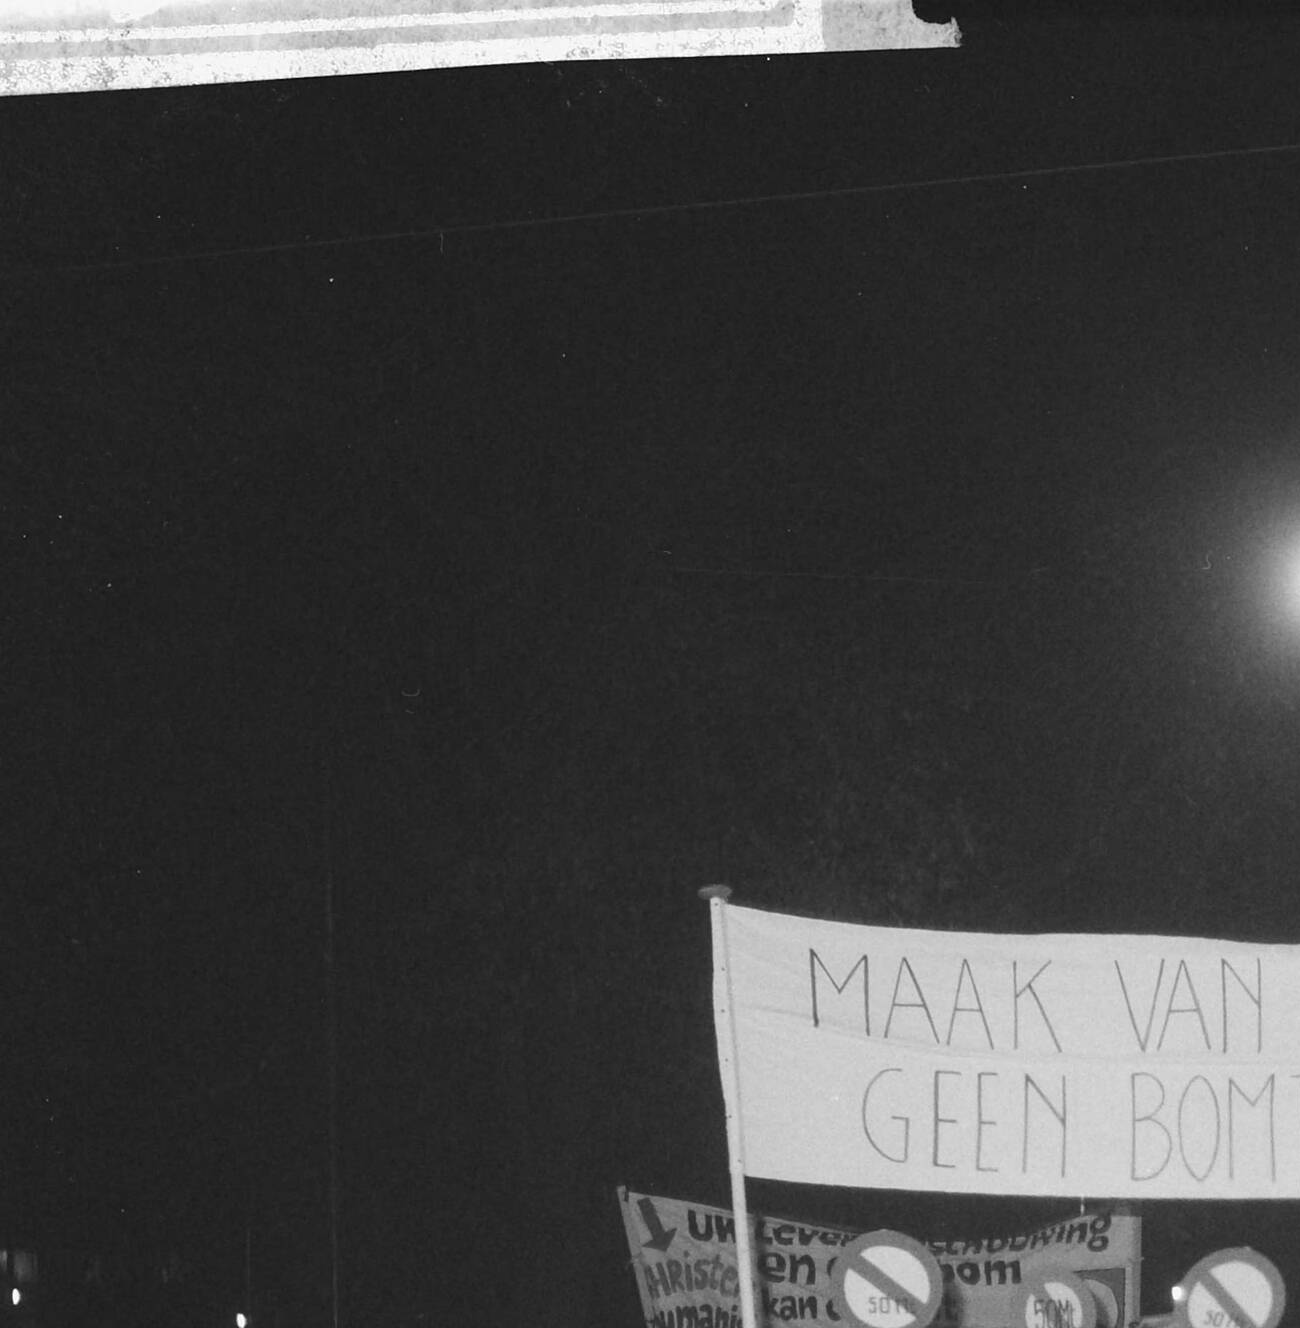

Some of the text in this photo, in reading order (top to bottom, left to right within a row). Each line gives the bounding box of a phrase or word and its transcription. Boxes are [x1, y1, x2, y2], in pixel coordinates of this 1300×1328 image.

[809, 947, 1062, 1053] MAAK
[1113, 956, 1261, 1054] VAN
[862, 1067, 1067, 1179] GEEN
